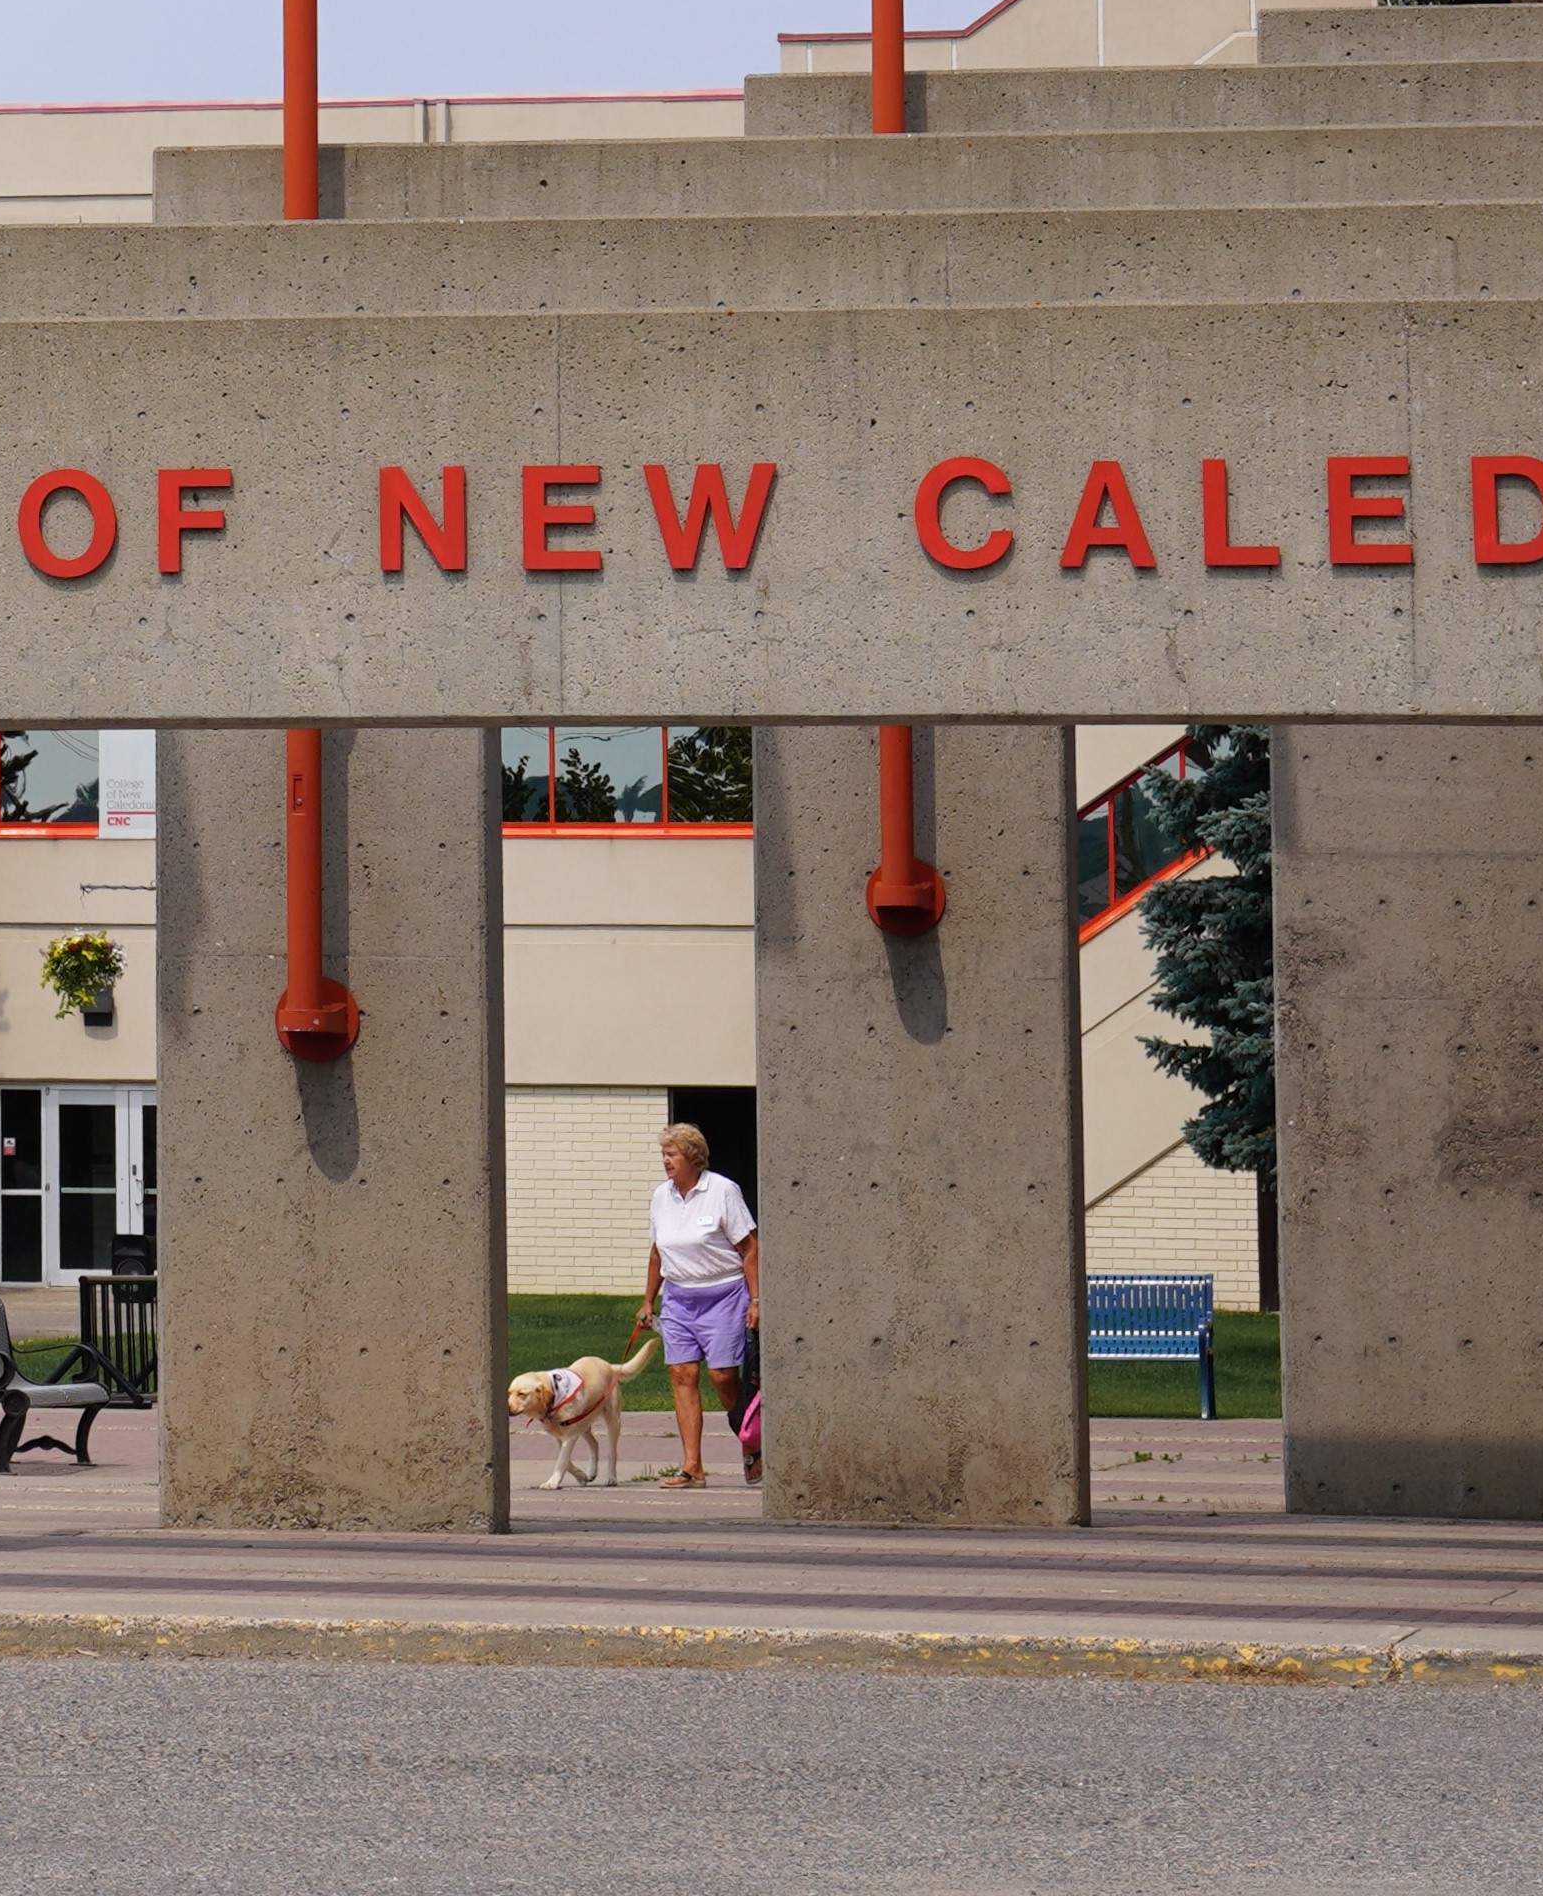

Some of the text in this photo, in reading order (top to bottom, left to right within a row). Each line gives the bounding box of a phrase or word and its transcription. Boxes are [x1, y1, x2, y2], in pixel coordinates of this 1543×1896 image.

[16, 467, 233, 578] OF
[378, 462, 776, 571] NEW
[106, 778, 145, 790] College
[106, 789, 142, 800] of New
[106, 799, 156, 810] Caledoni
[107, 816, 131, 826] CNC
